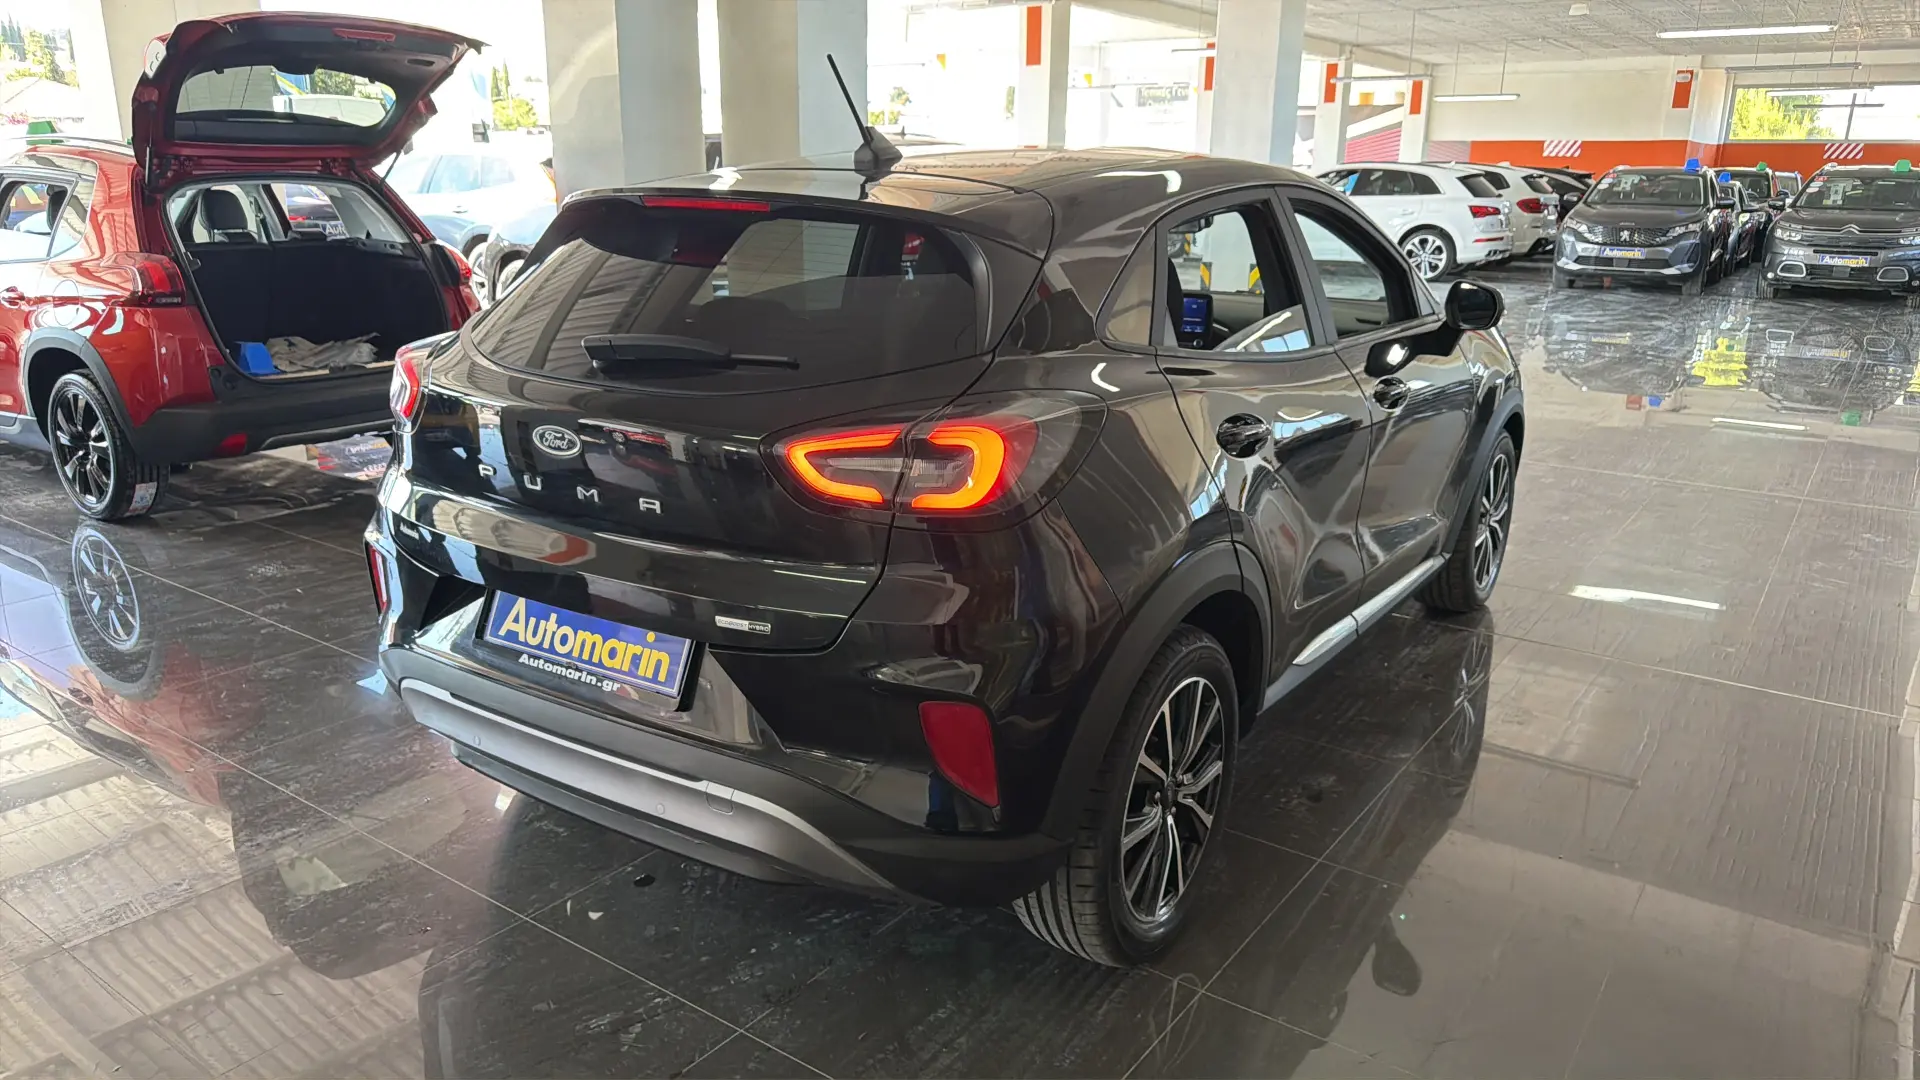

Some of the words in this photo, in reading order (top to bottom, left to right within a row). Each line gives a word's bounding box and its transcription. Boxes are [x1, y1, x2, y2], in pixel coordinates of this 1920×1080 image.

[542, 430, 569, 449] Ford
[478, 463, 662, 514] PUMA
[498, 597, 671, 682] Automarin
[518, 653, 621, 692] Automarin.gr
